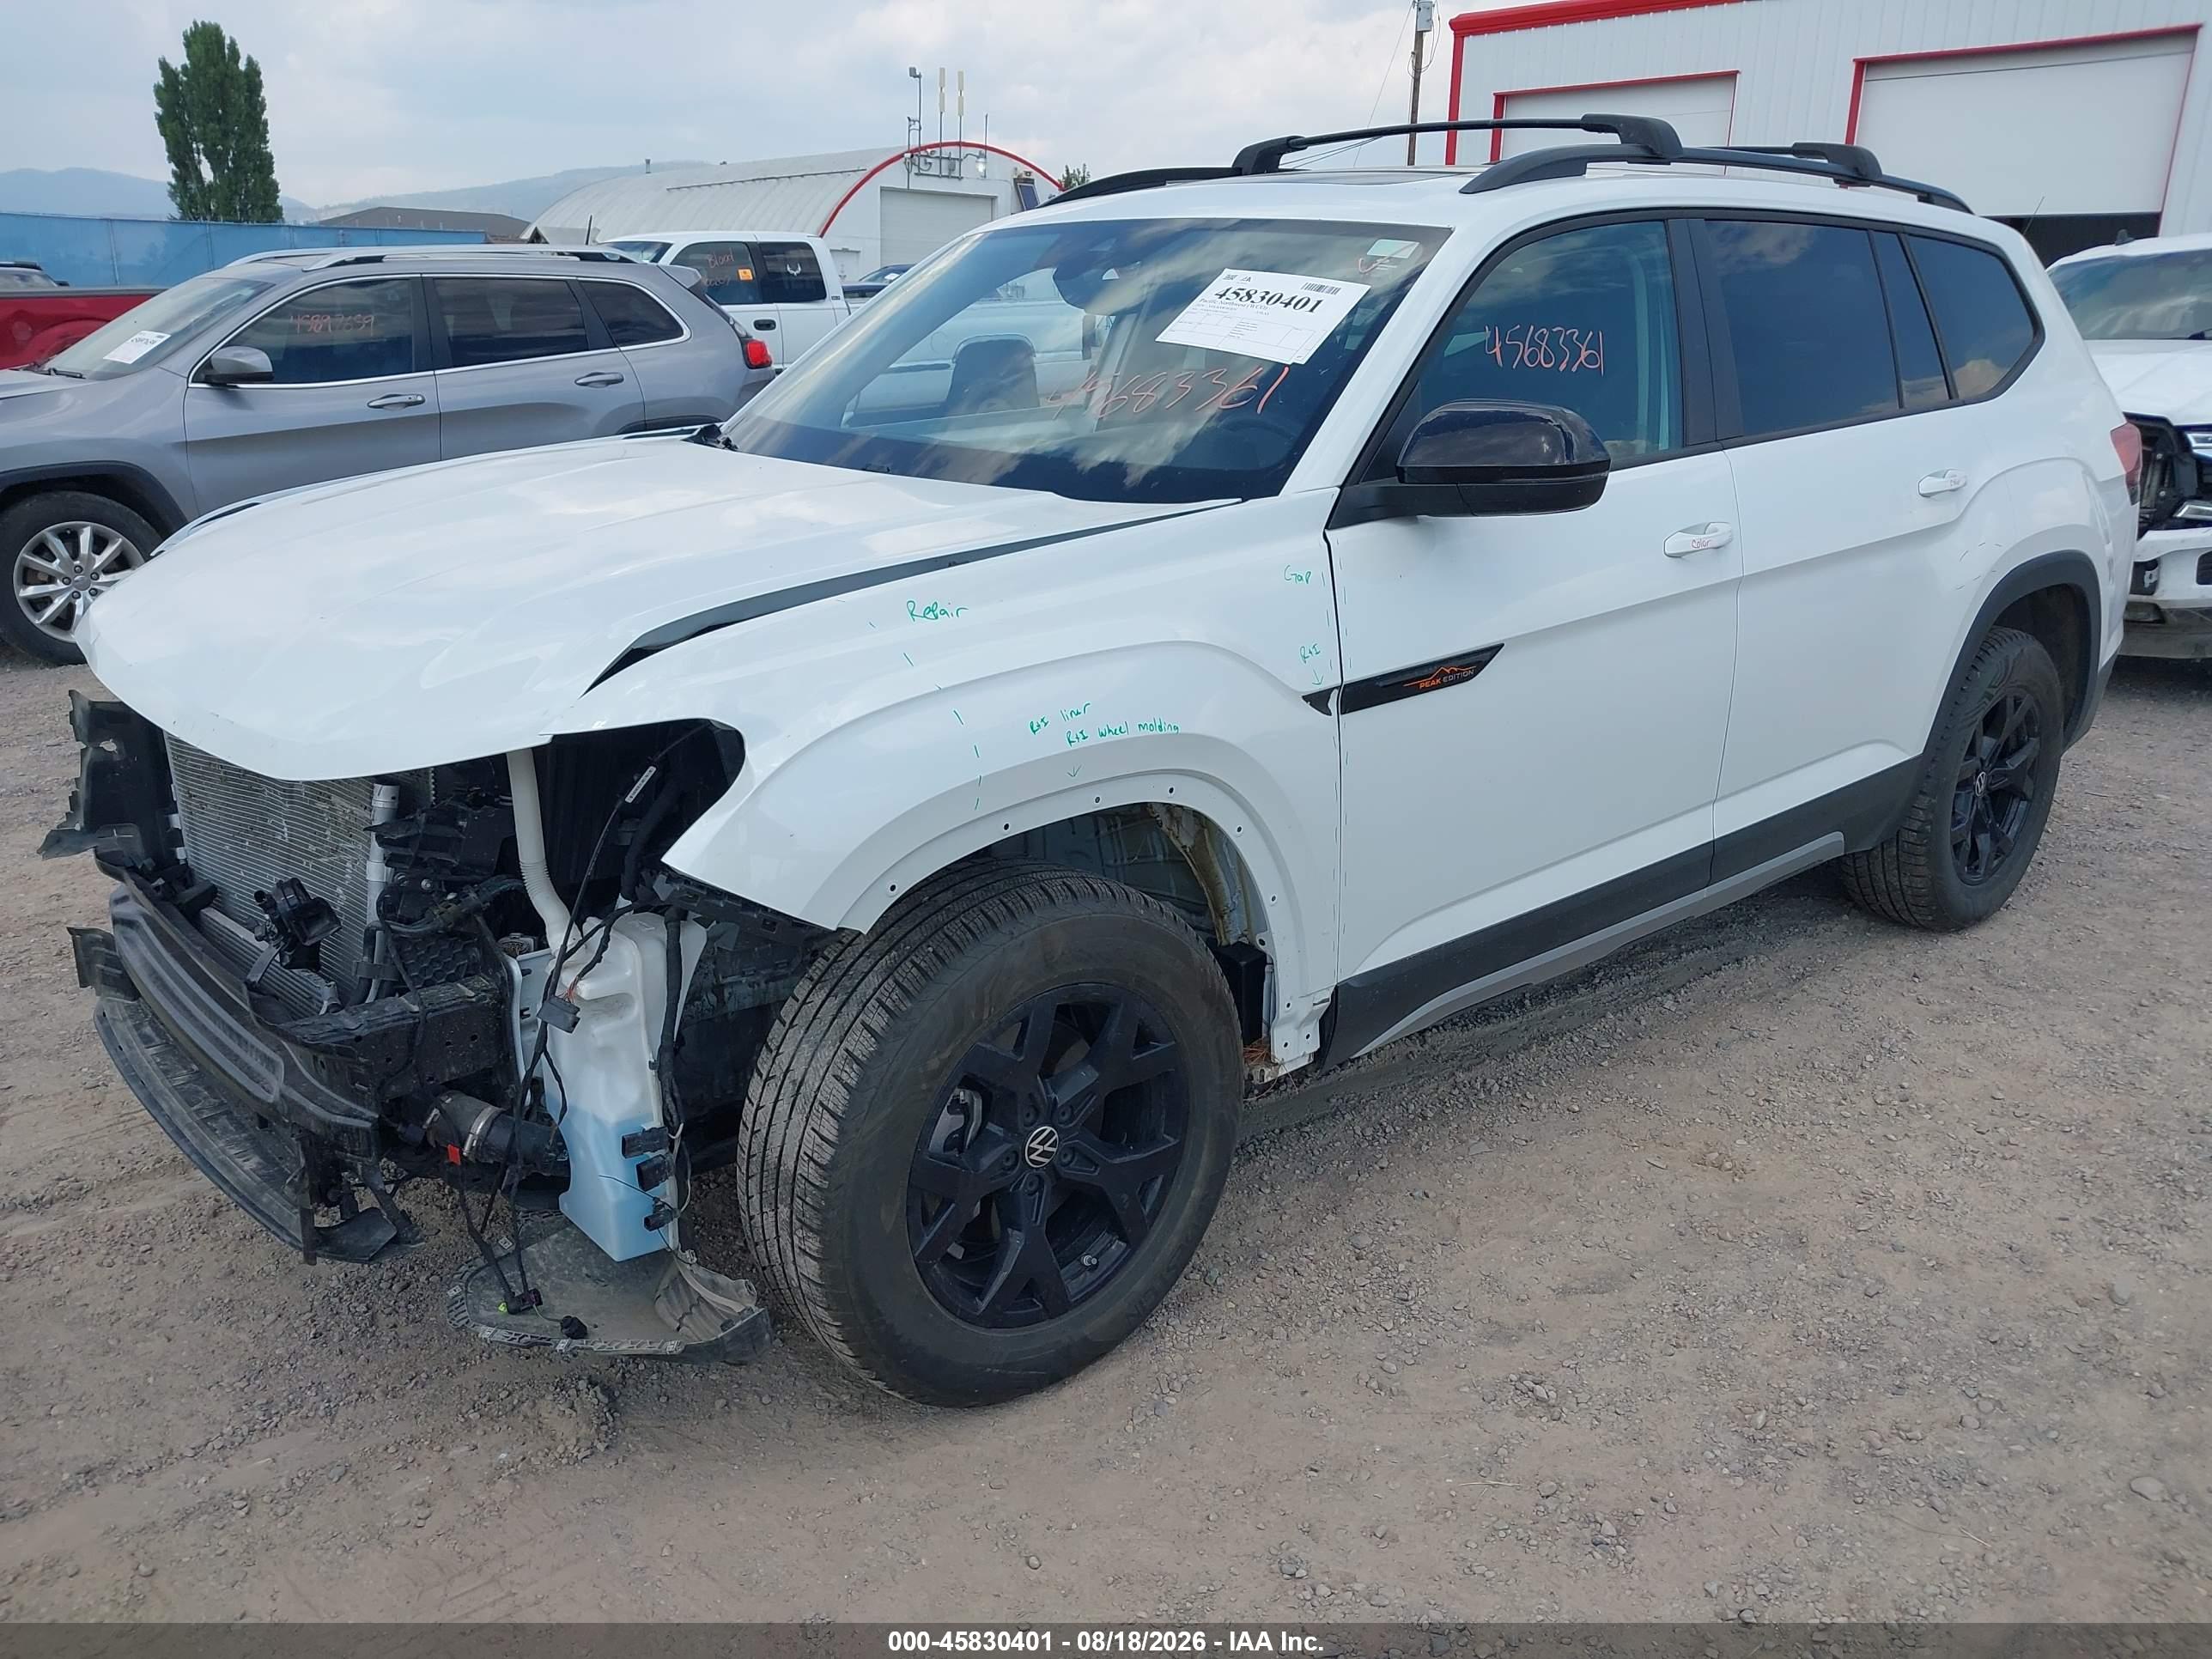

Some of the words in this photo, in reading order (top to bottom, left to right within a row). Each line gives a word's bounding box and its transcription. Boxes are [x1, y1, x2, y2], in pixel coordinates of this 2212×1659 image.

[1214, 286, 1324, 313] 45830401
[1484, 325, 1605, 376] 45683361
[906, 599, 969, 622] Repair
[1419, 678, 1442, 690] PEAK
[1443, 669, 1475, 683] EDITION
[1138, 717, 1181, 735] molding
